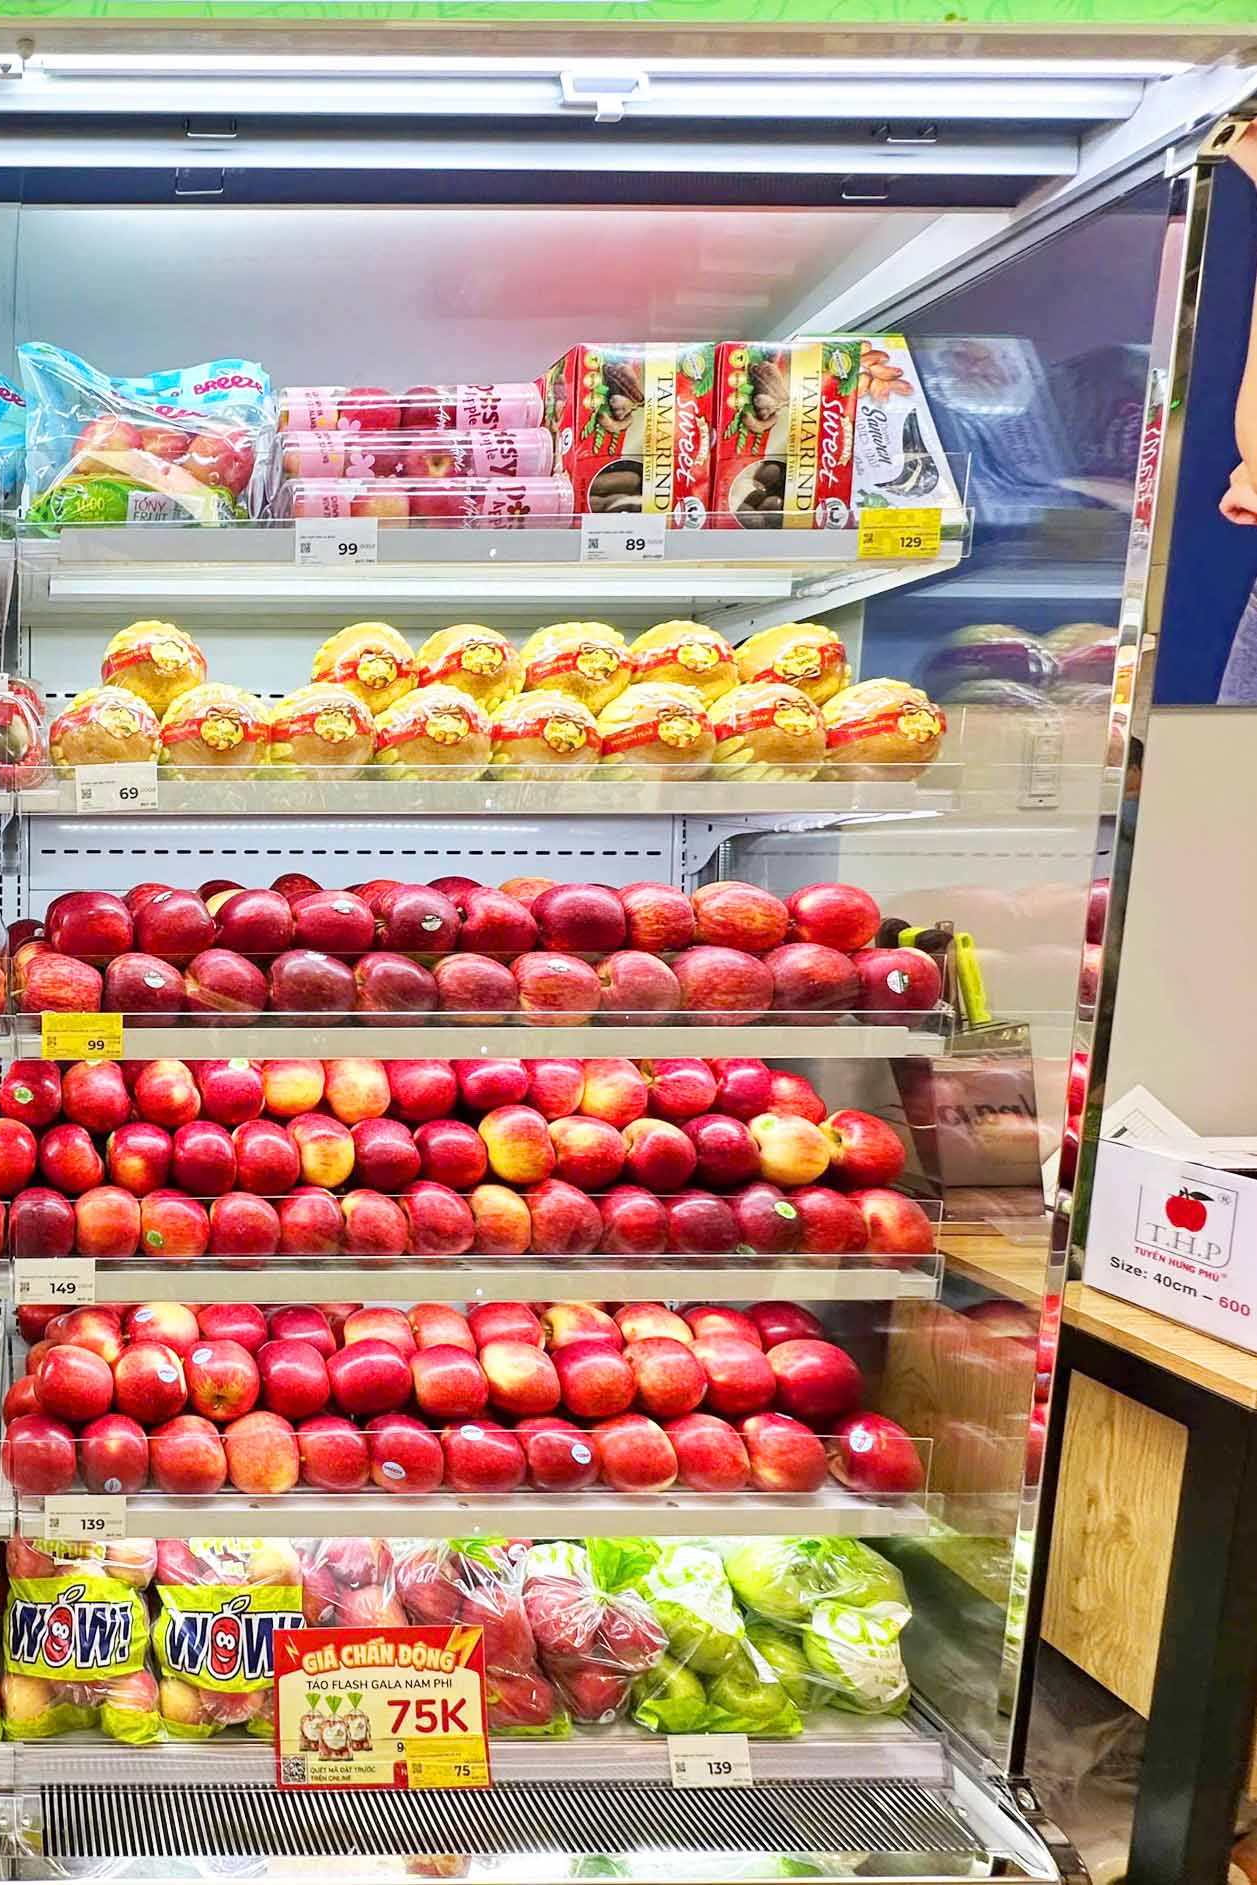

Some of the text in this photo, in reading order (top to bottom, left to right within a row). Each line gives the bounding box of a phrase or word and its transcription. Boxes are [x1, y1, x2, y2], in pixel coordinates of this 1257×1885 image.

[654, 371, 674, 510] TAMARIND
[676, 396, 699, 487] Sweet
[796, 370, 820, 510] TAMARIND
[819, 396, 843, 488] Sweet
[338, 543, 357, 556] 99
[625, 538, 646, 551] 89
[900, 537, 922, 549] 129
[119, 787, 139, 800] 69
[87, 1040, 105, 1050] 99
[1146, 1222, 1222, 1261] T.H.P
[49, 1282, 76, 1294] 149
[1110, 1255, 1148, 1280] Size:
[1152, 1272, 1198, 1298] 40cm
[1218, 1295, 1251, 1317] 600
[81, 1519, 105, 1530] 139
[9, 1597, 134, 1669] WOW!
[302, 1638, 457, 1676] GIÁ CHẤN ĐỘNG
[306, 1678, 452, 1690] TÁO FLASH GALA NAM PHI
[387, 1698, 469, 1734] 75K
[454, 1765, 471, 1776] 75
[707, 1761, 732, 1775] 139
